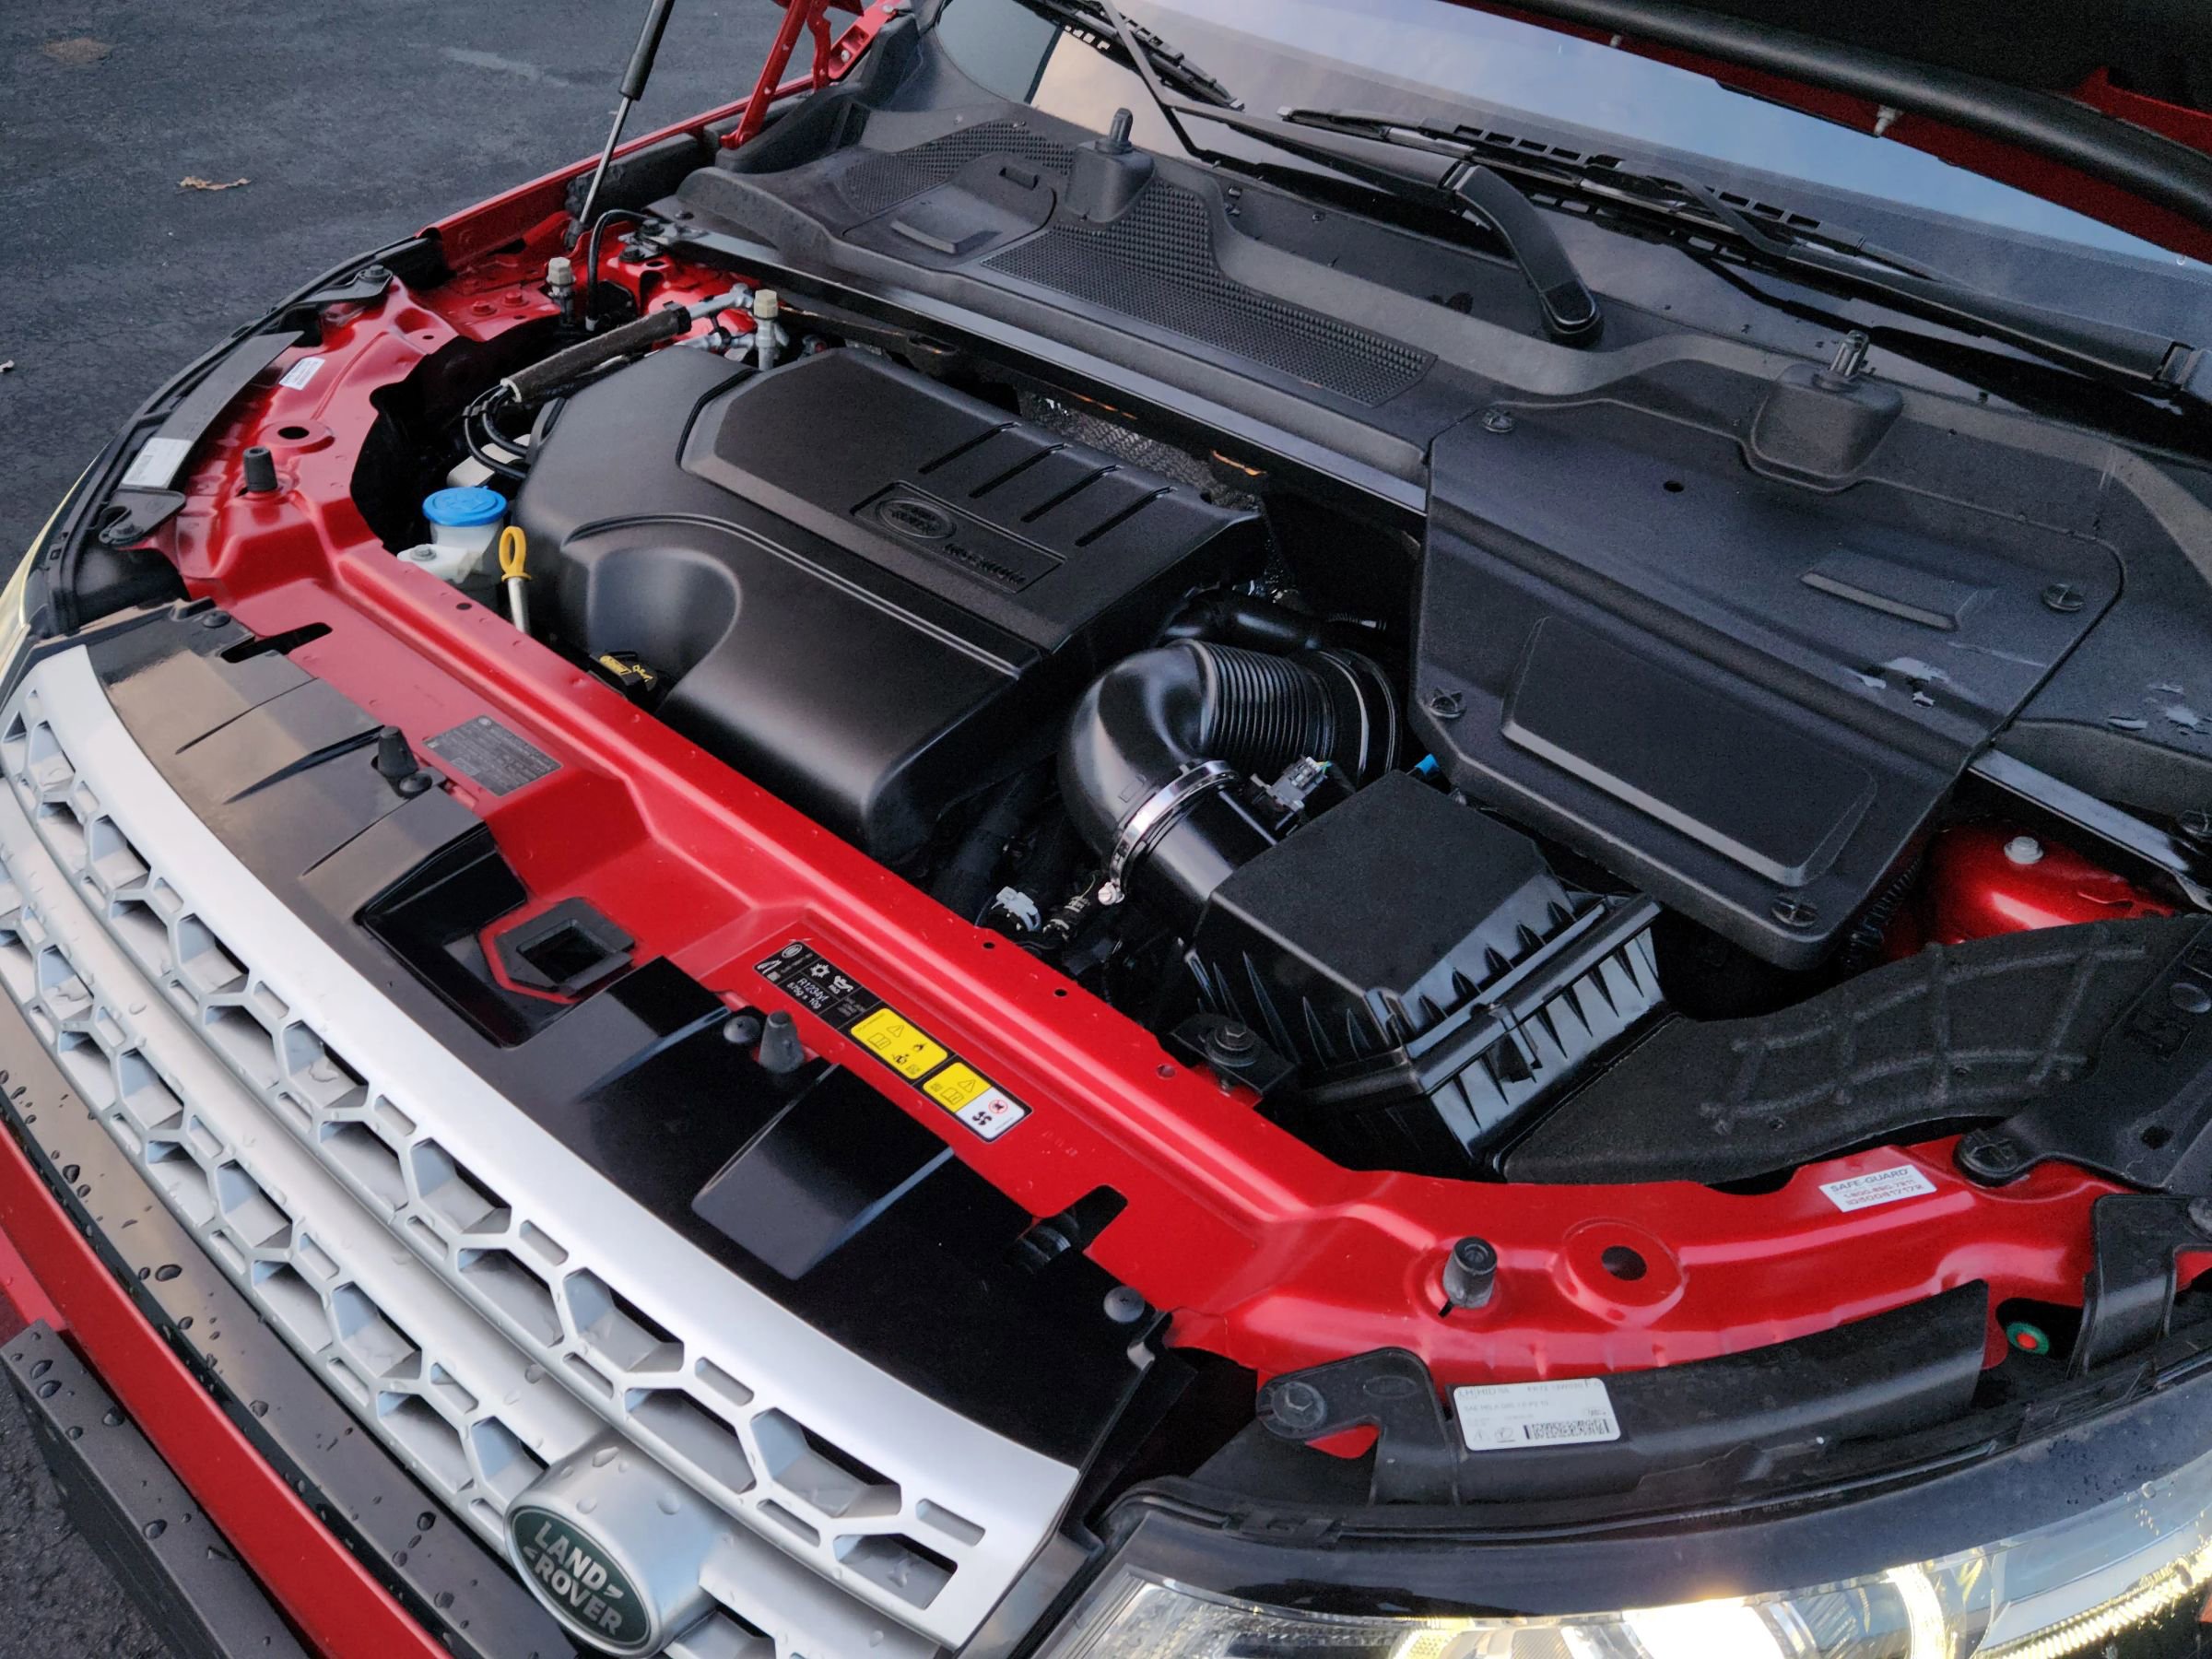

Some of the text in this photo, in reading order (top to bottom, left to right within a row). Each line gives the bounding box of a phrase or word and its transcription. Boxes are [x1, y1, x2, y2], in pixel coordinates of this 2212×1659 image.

[1830, 1168, 1909, 1192] SAFE-GUARD
[534, 1521, 608, 1592] LAND
[535, 1554, 623, 1636] ROVER
